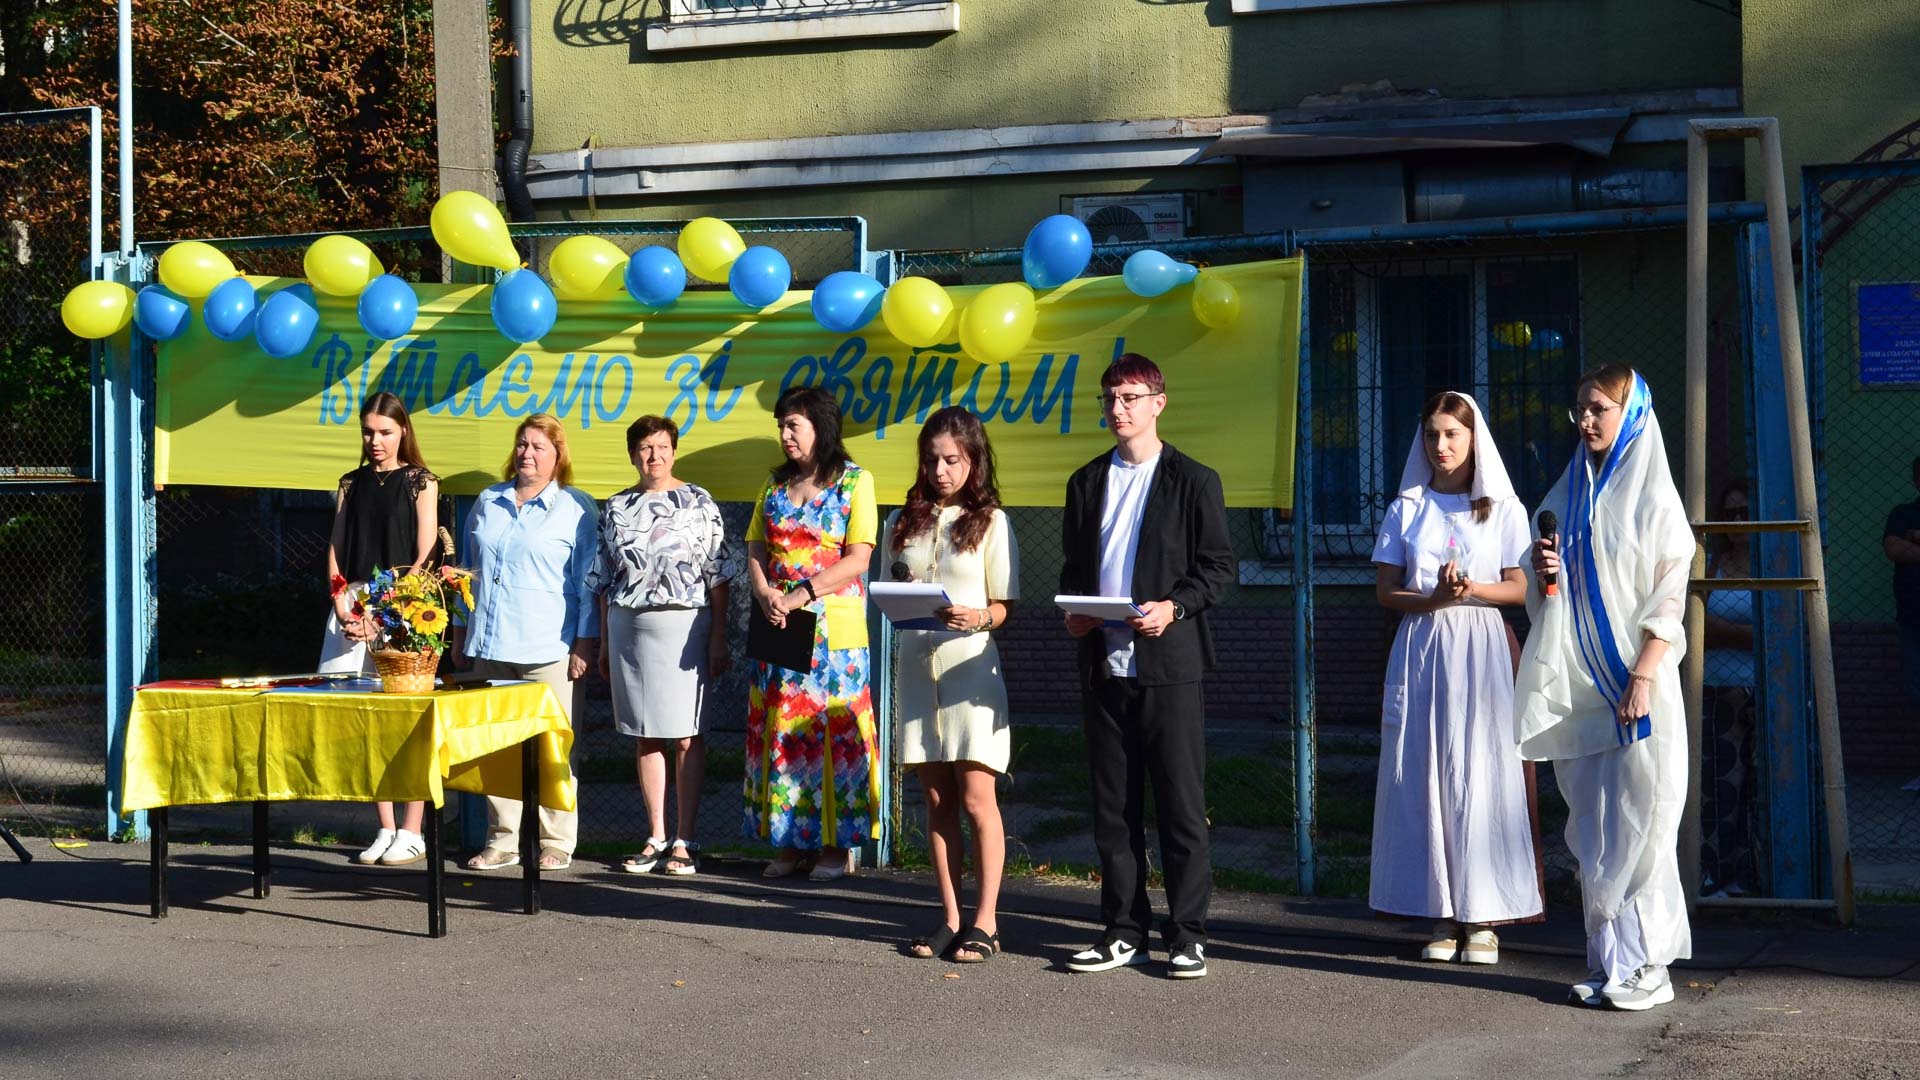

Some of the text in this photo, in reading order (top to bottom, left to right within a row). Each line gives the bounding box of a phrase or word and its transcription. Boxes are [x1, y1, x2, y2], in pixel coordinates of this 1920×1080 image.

[312, 333, 634, 430] Вітаємо
[664, 339, 744, 439] зі
[779, 336, 1081, 440] святом
